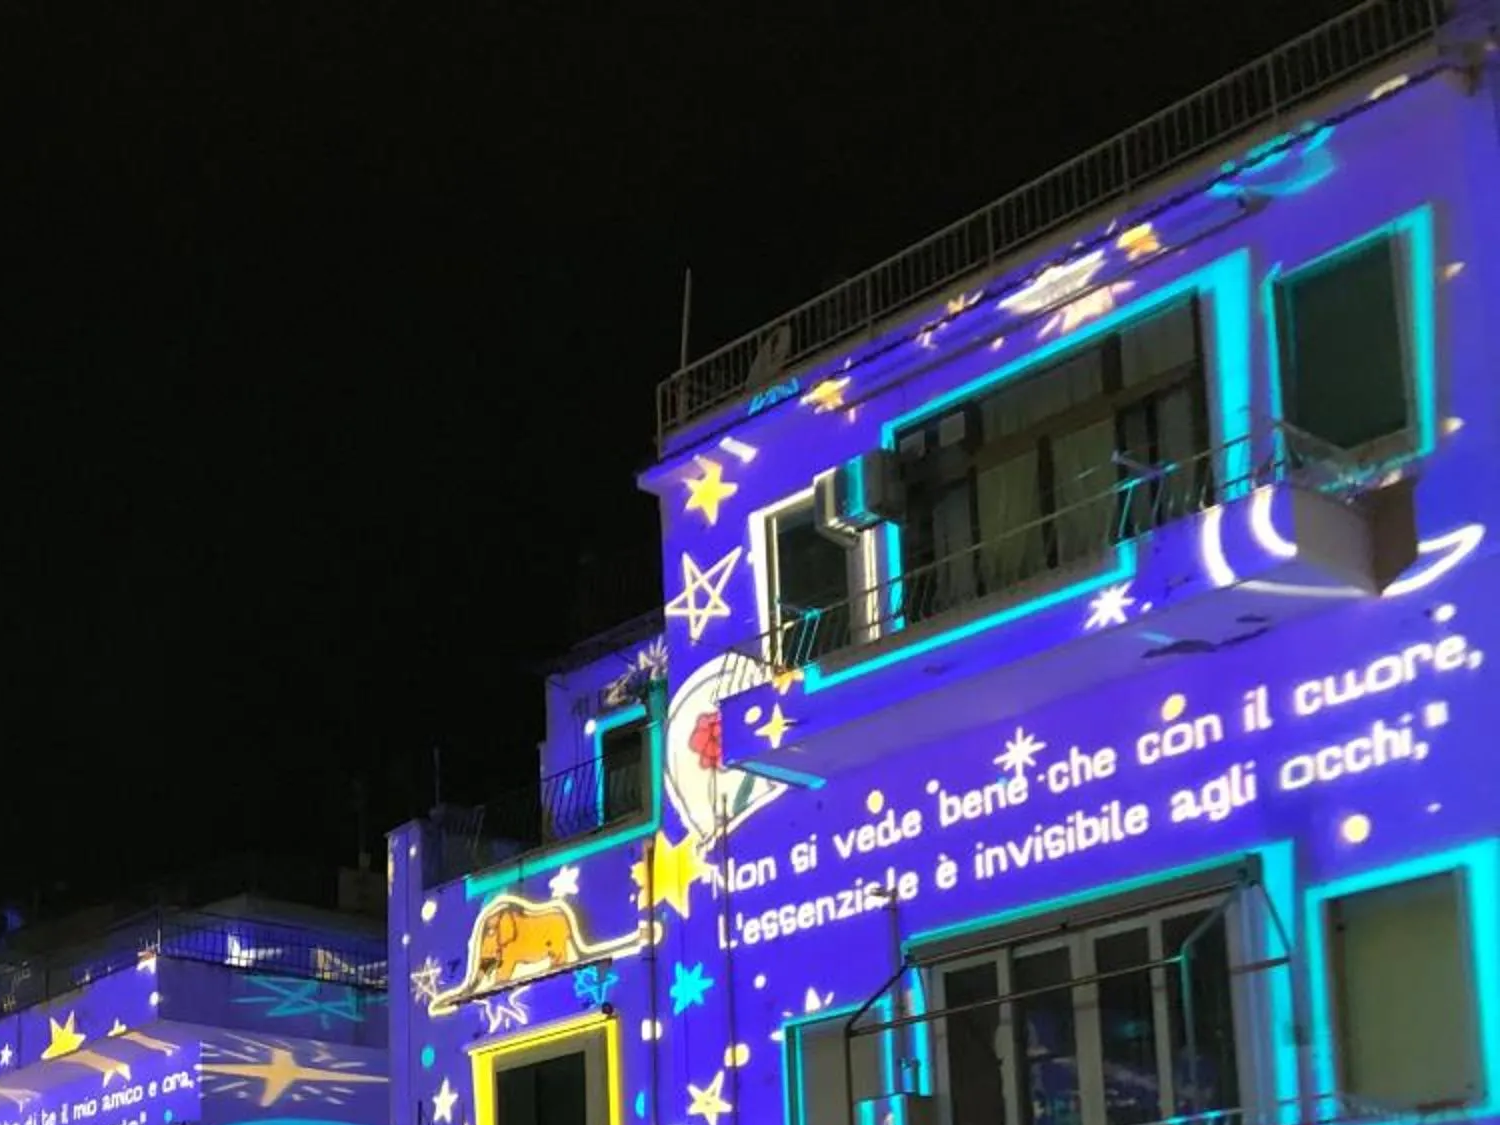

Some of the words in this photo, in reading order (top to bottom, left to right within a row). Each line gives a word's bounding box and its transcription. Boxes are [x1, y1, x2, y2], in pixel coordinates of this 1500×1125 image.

[790, 833, 818, 874] si
[833, 808, 923, 860] vede
[938, 775, 1029, 828] bene
[1047, 745, 1117, 794] che
[1136, 712, 1224, 766] con
[1243, 684, 1273, 732] il
[1293, 634, 1484, 717] cuore,
[718, 866, 920, 951] L'essenziale
[935, 853, 958, 890] è
[974, 799, 1150, 881] invisibile
[1170, 759, 1258, 823] agli
[101, 1083, 144, 1112] amico
[147, 1080, 158, 1098] e
